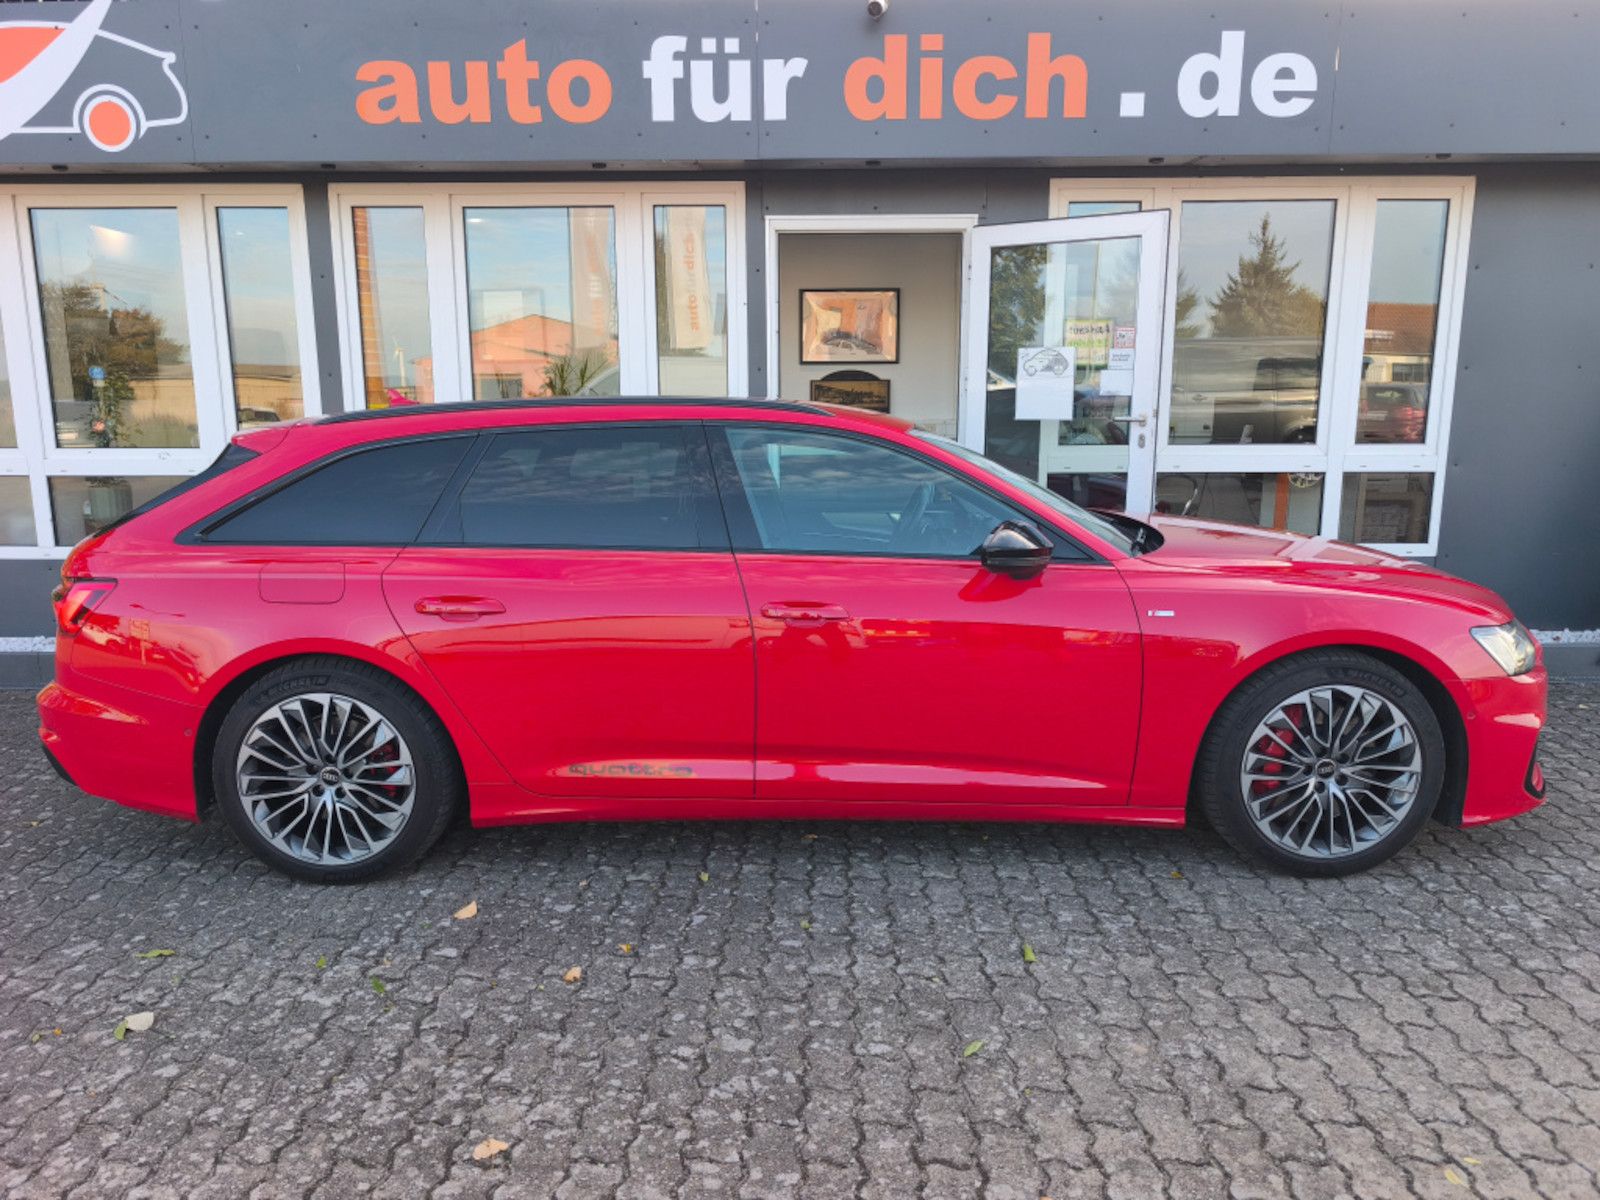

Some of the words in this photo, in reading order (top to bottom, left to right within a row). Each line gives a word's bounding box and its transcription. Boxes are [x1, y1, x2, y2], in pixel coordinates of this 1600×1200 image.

[355, 37, 613, 126] auto
[642, 35, 809, 123] für
[843, 32, 1089, 121] dich
[1177, 30, 1319, 119] de
[568, 762, 693, 778] quattro
